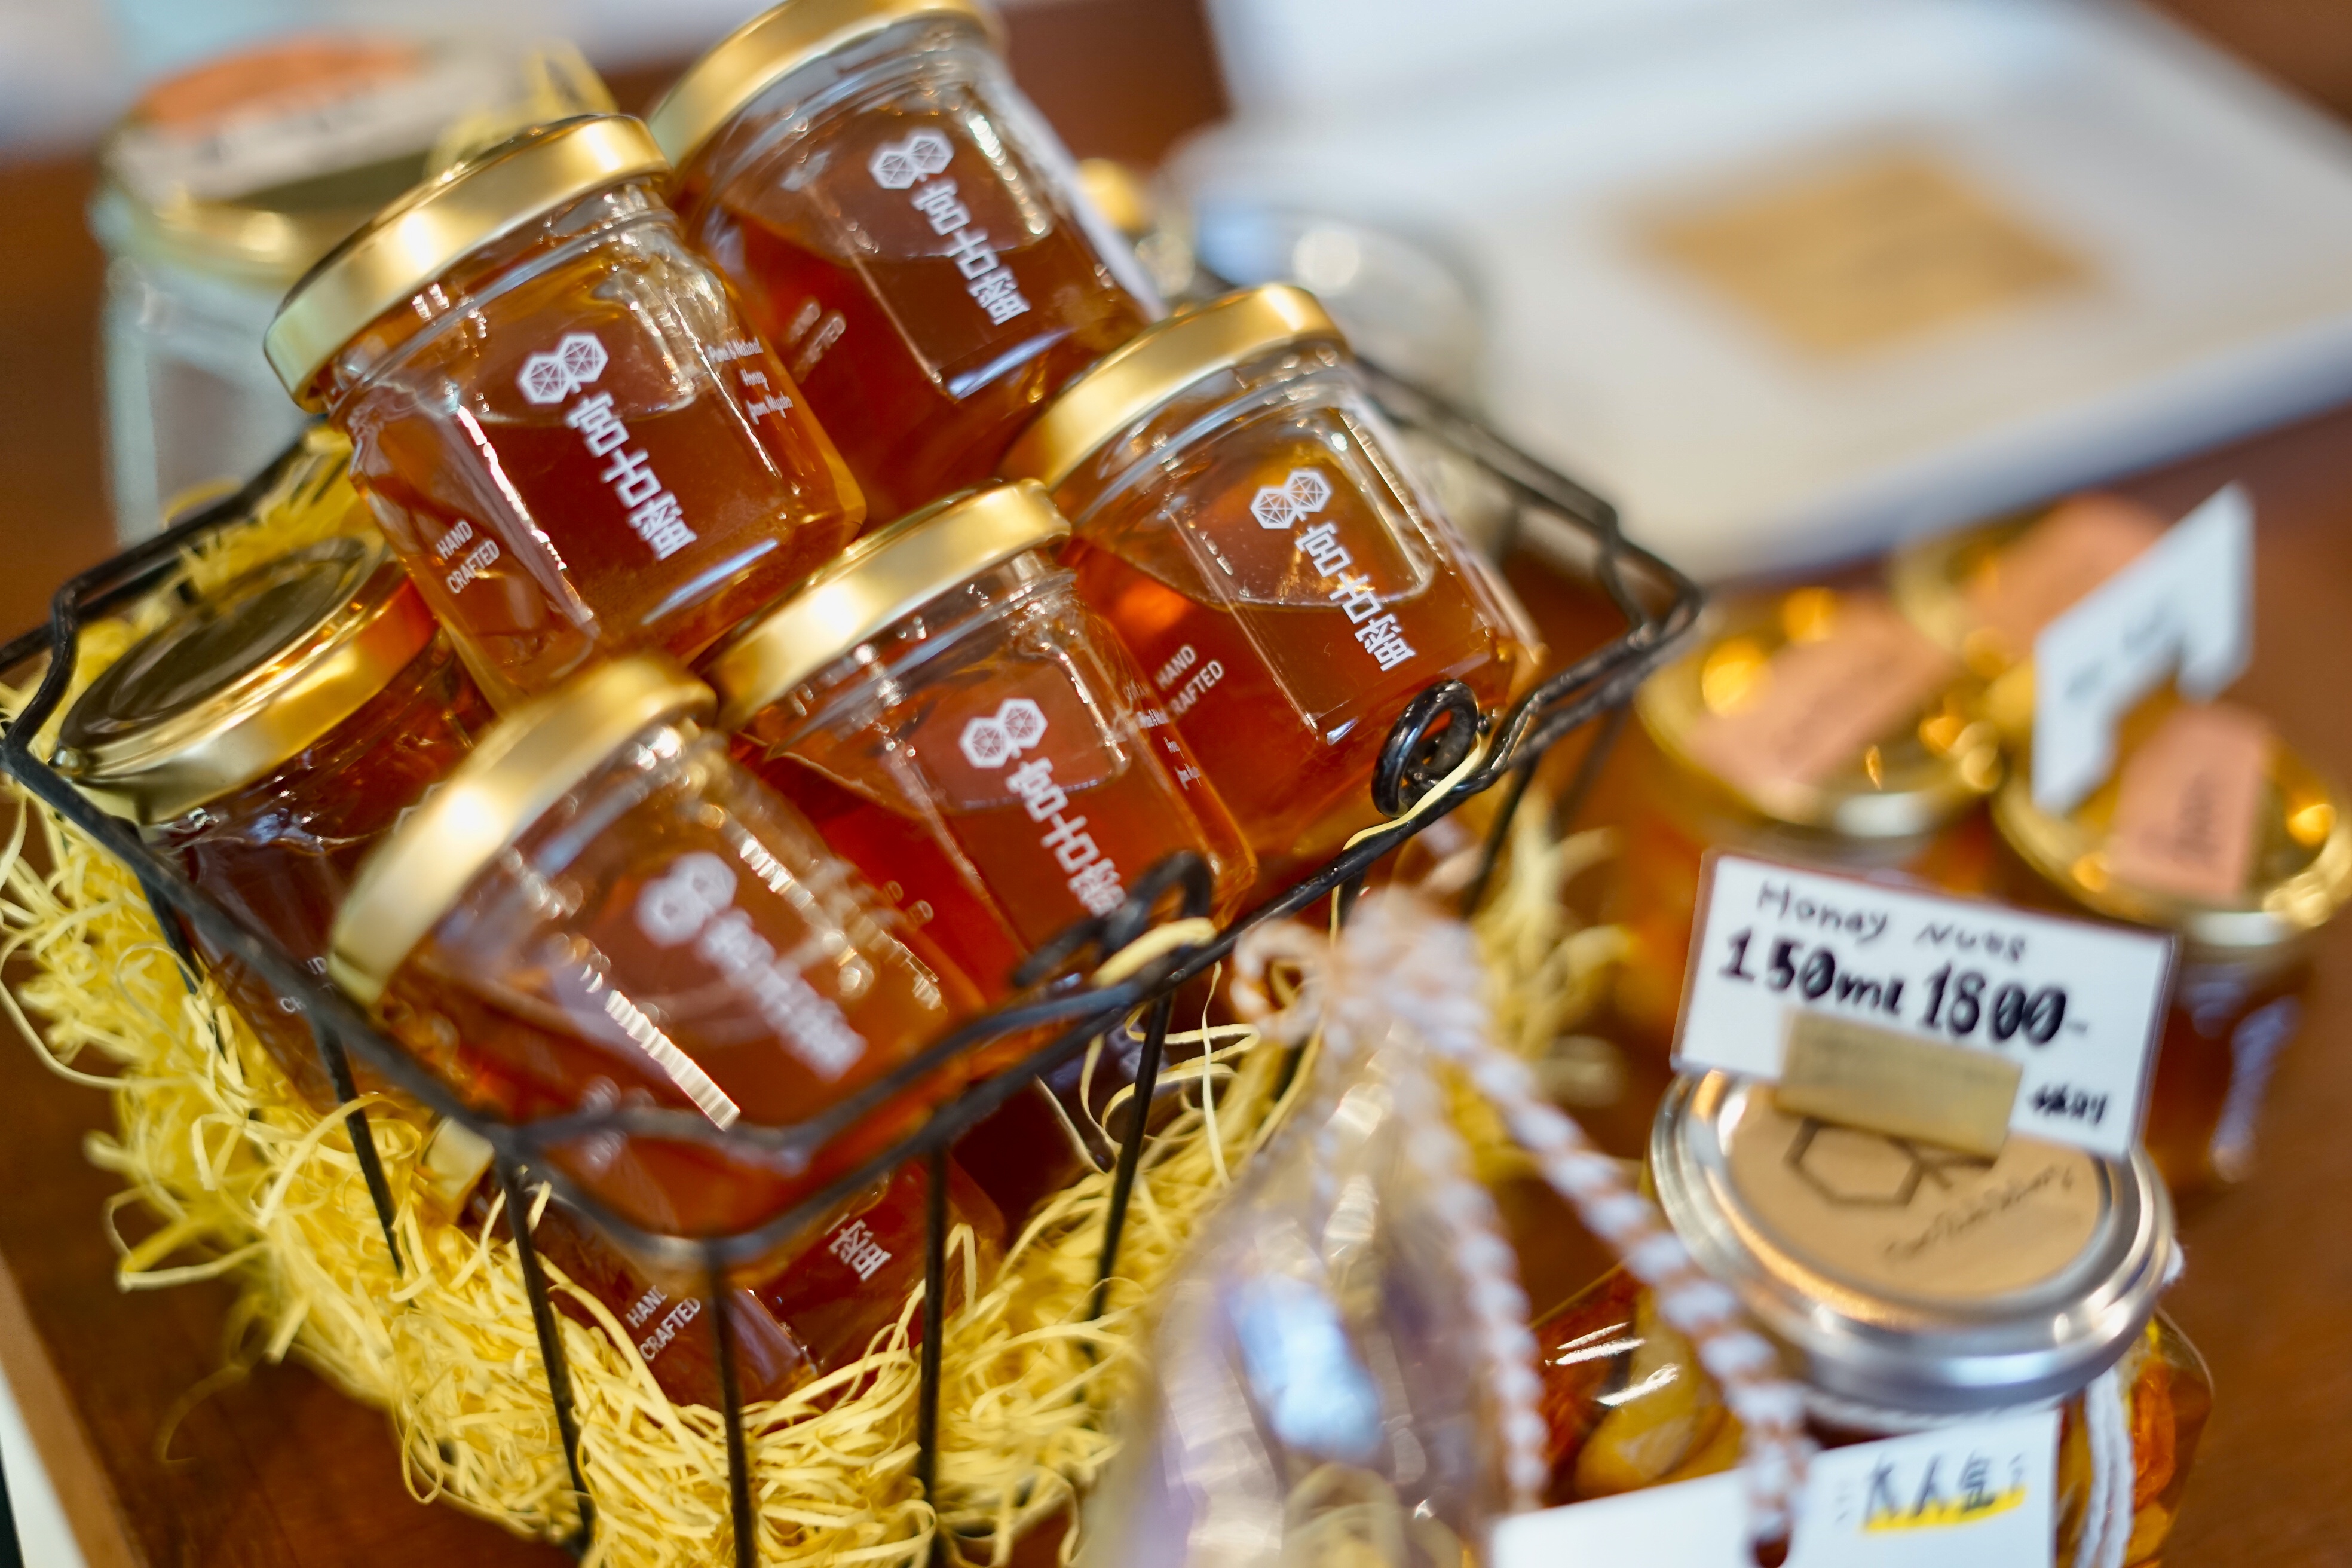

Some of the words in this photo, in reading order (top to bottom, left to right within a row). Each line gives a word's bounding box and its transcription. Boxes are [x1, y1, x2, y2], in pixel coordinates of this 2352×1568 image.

[912, 182, 1031, 326] 宮古蜜
[740, 368, 770, 391] Honey
[746, 399, 770, 425] from
[765, 391, 794, 418] Miyako
[566, 391, 697, 560] 宮古蜜
[436, 520, 473, 560] HAND
[446, 539, 500, 594] CRAFTED
[1294, 522, 1416, 672] 宮古蜜
[1169, 659, 1224, 717] RAFTED
[1757, 880, 1888, 944] Honey
[1720, 926, 1906, 1016] 150ml
[639, 1297, 701, 1361] CRAFTED
